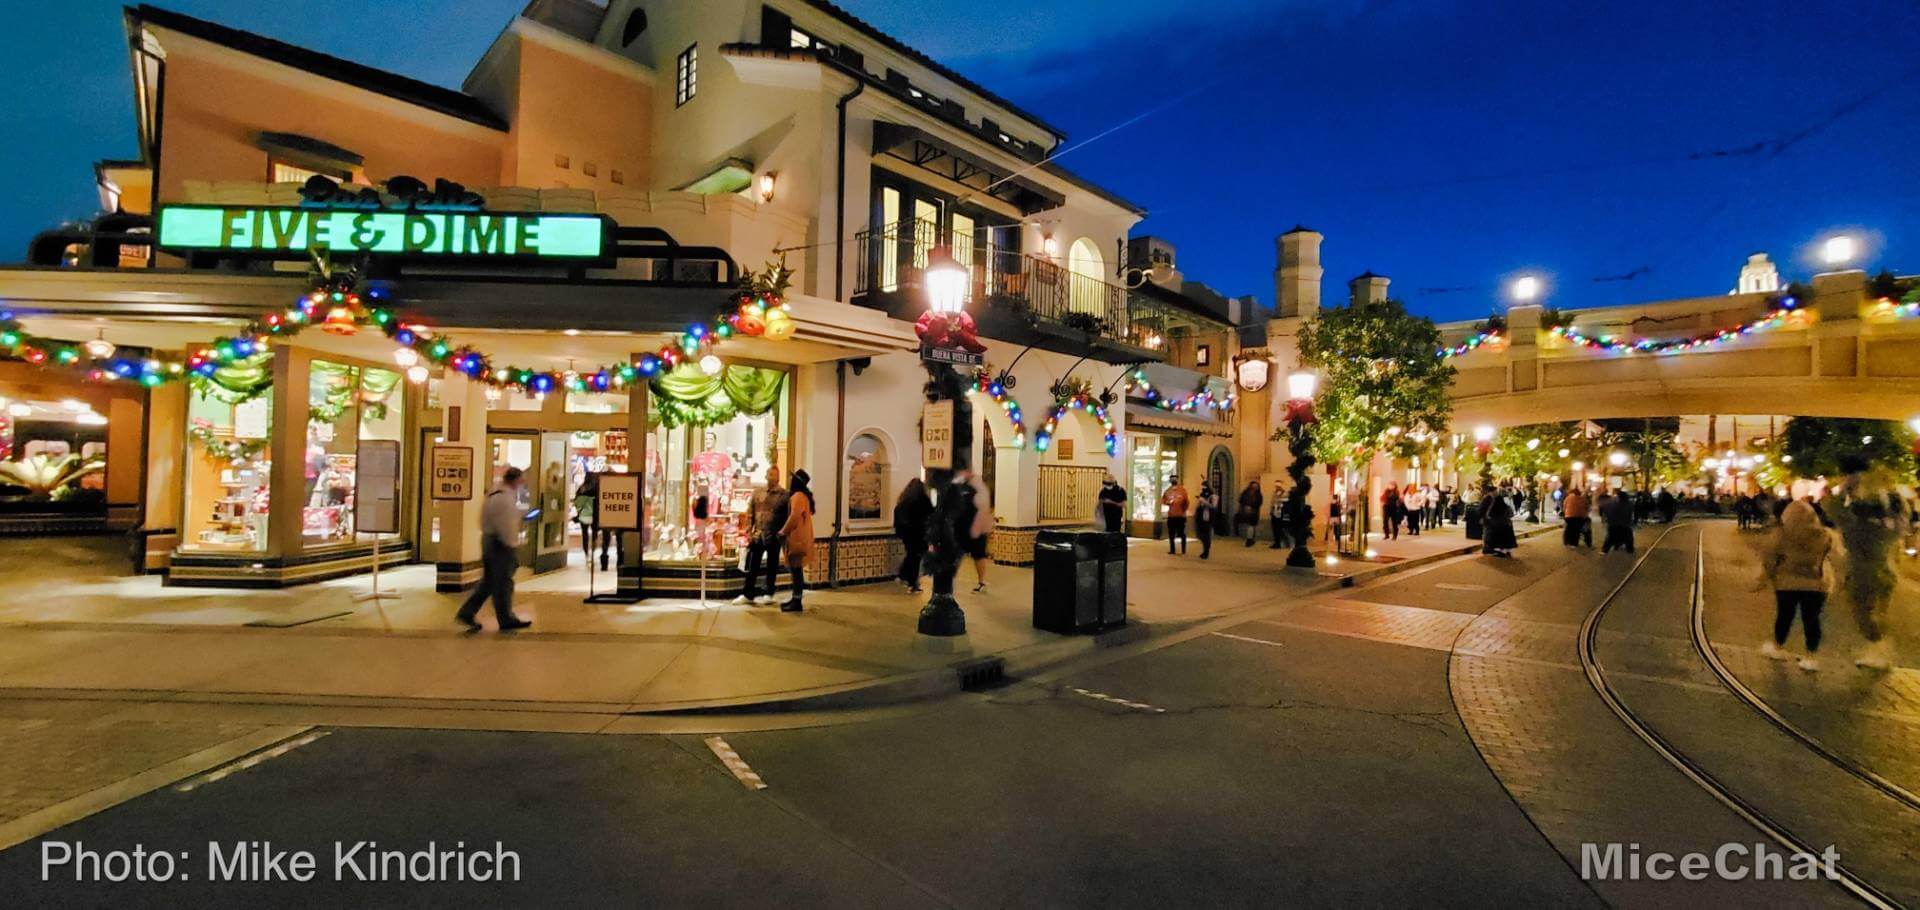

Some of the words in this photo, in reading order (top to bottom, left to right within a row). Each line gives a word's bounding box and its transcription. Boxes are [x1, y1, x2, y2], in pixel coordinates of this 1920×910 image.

[221, 209, 332, 250] FIVE
[350, 213, 386, 251] &
[402, 214, 540, 255] DIME
[932, 349, 951, 360] BUENA
[952, 352, 967, 362] VISTA
[602, 492, 634, 500] ENTER
[605, 504, 631, 512] HERE
